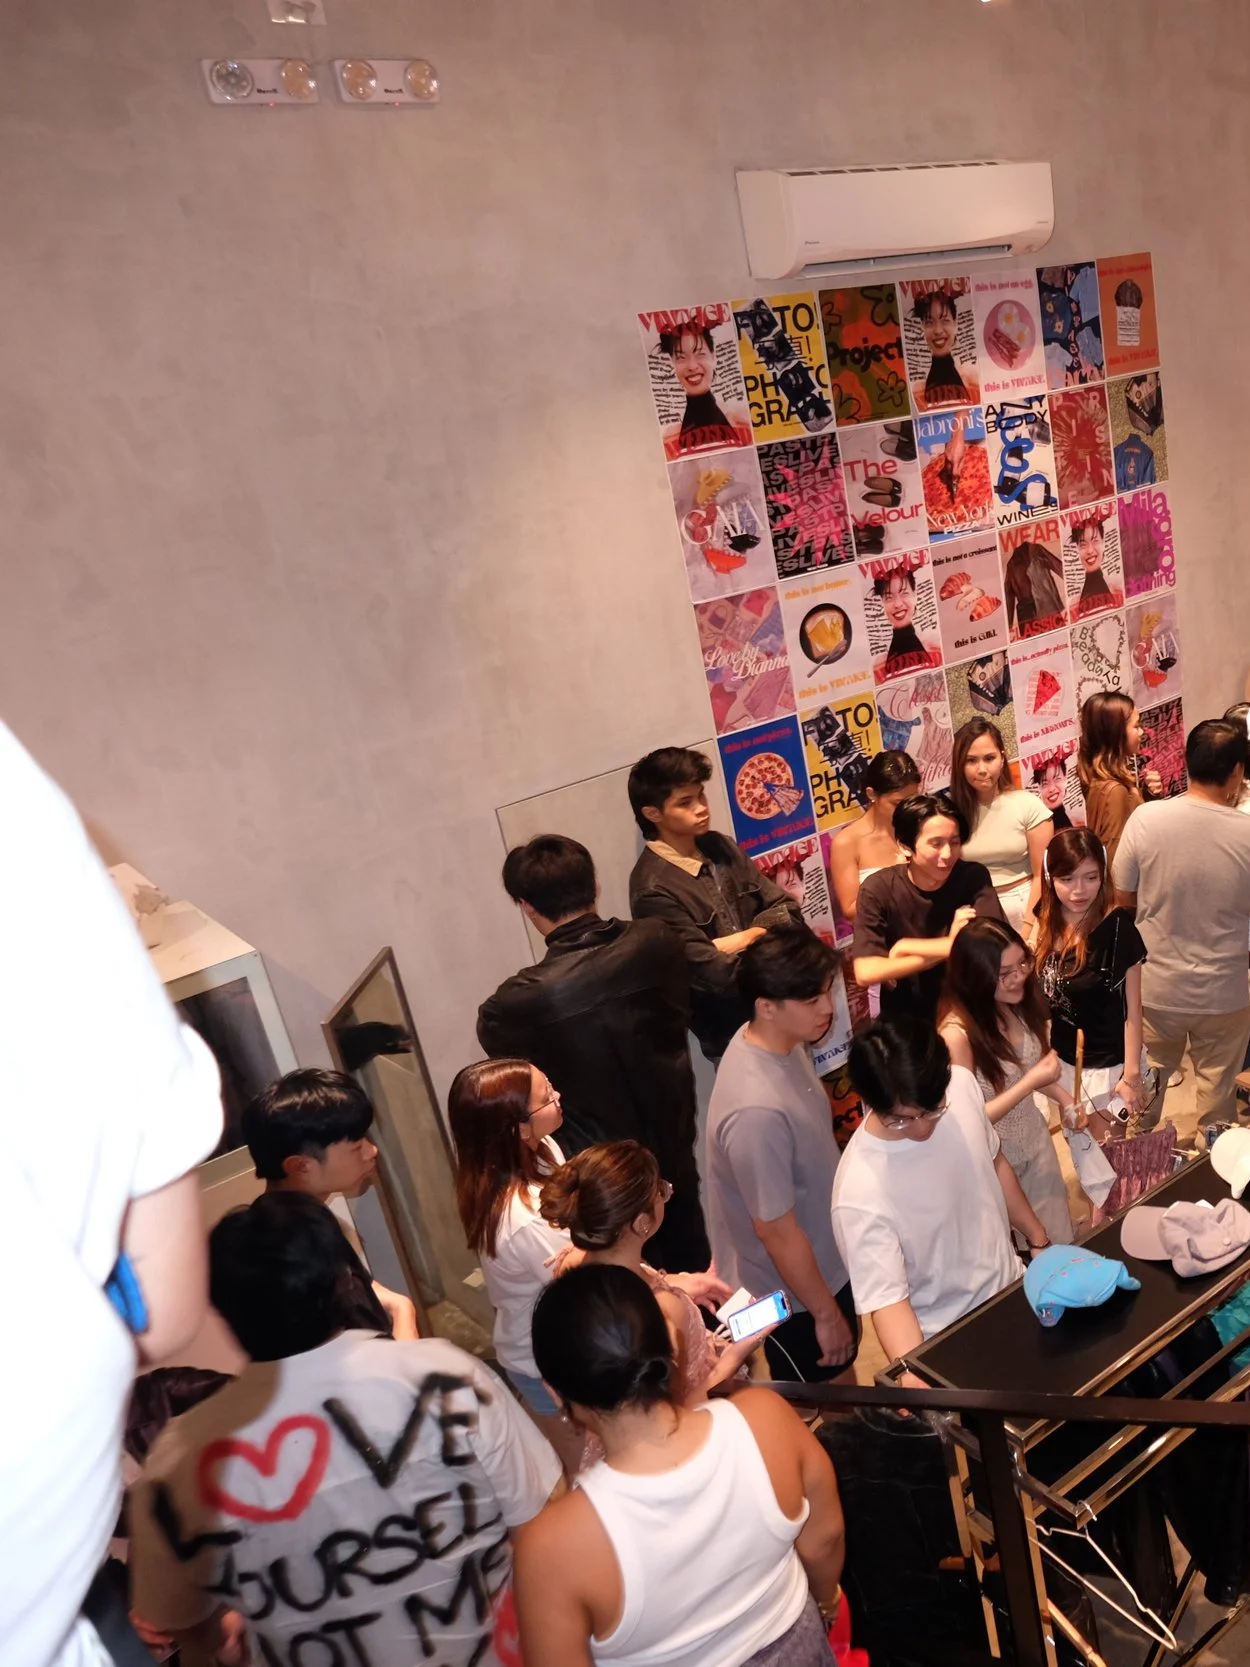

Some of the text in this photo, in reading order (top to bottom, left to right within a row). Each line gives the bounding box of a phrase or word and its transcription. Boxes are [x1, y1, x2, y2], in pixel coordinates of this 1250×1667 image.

[986, 409, 1048, 434] BODY
[844, 458, 898, 482] The
[850, 503, 924, 529] Velour
[997, 503, 1058, 526] WINES
[943, 519, 981, 535] PIZZA
[1001, 516, 1061, 553] WEAR
[955, 635, 978, 649] this is
[705, 646, 742, 672] Love
[1020, 731, 1033, 744] this
